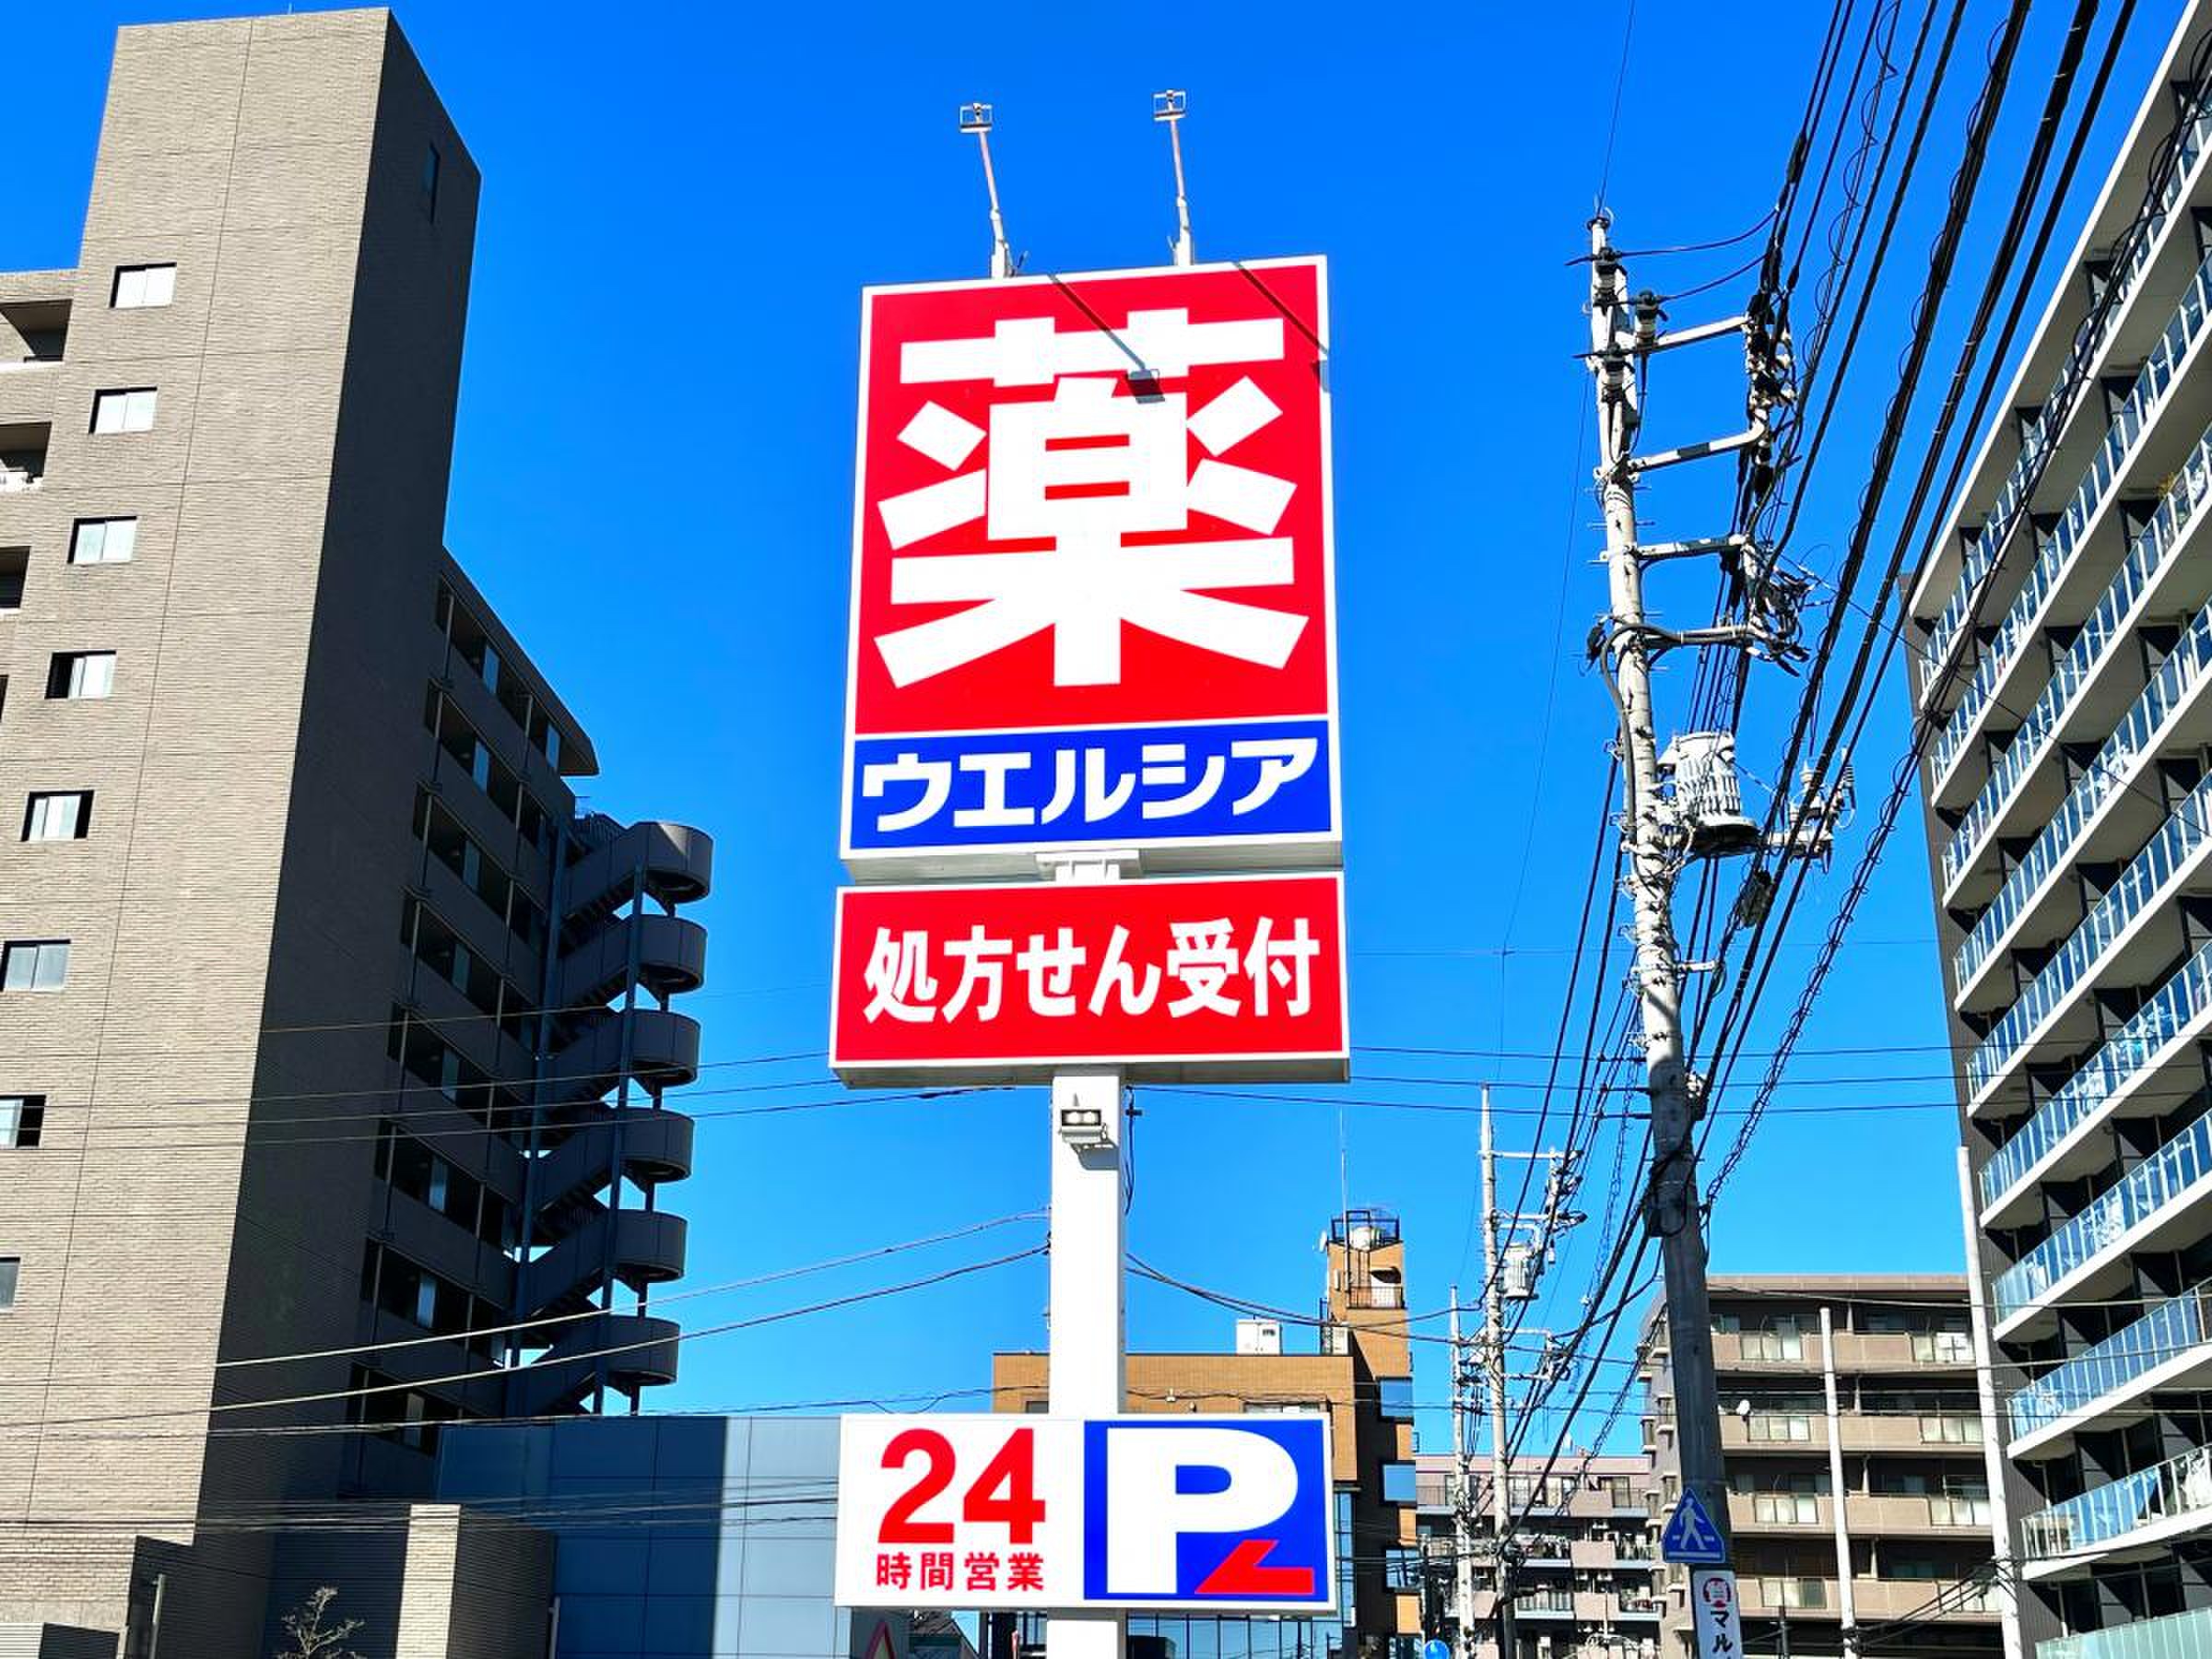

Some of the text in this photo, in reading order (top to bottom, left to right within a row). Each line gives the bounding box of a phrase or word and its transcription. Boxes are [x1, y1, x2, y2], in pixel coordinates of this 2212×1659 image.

[873, 307, 1310, 689] 薬
[862, 737, 1318, 832] ウエルシア
[863, 915, 1321, 1024] 処方せん受付
[877, 1428, 1047, 1545] 24
[1106, 1427, 1300, 1594] P
[876, 1551, 1046, 1593] 時間営業
[1710, 1610, 1734, 1659] マル
